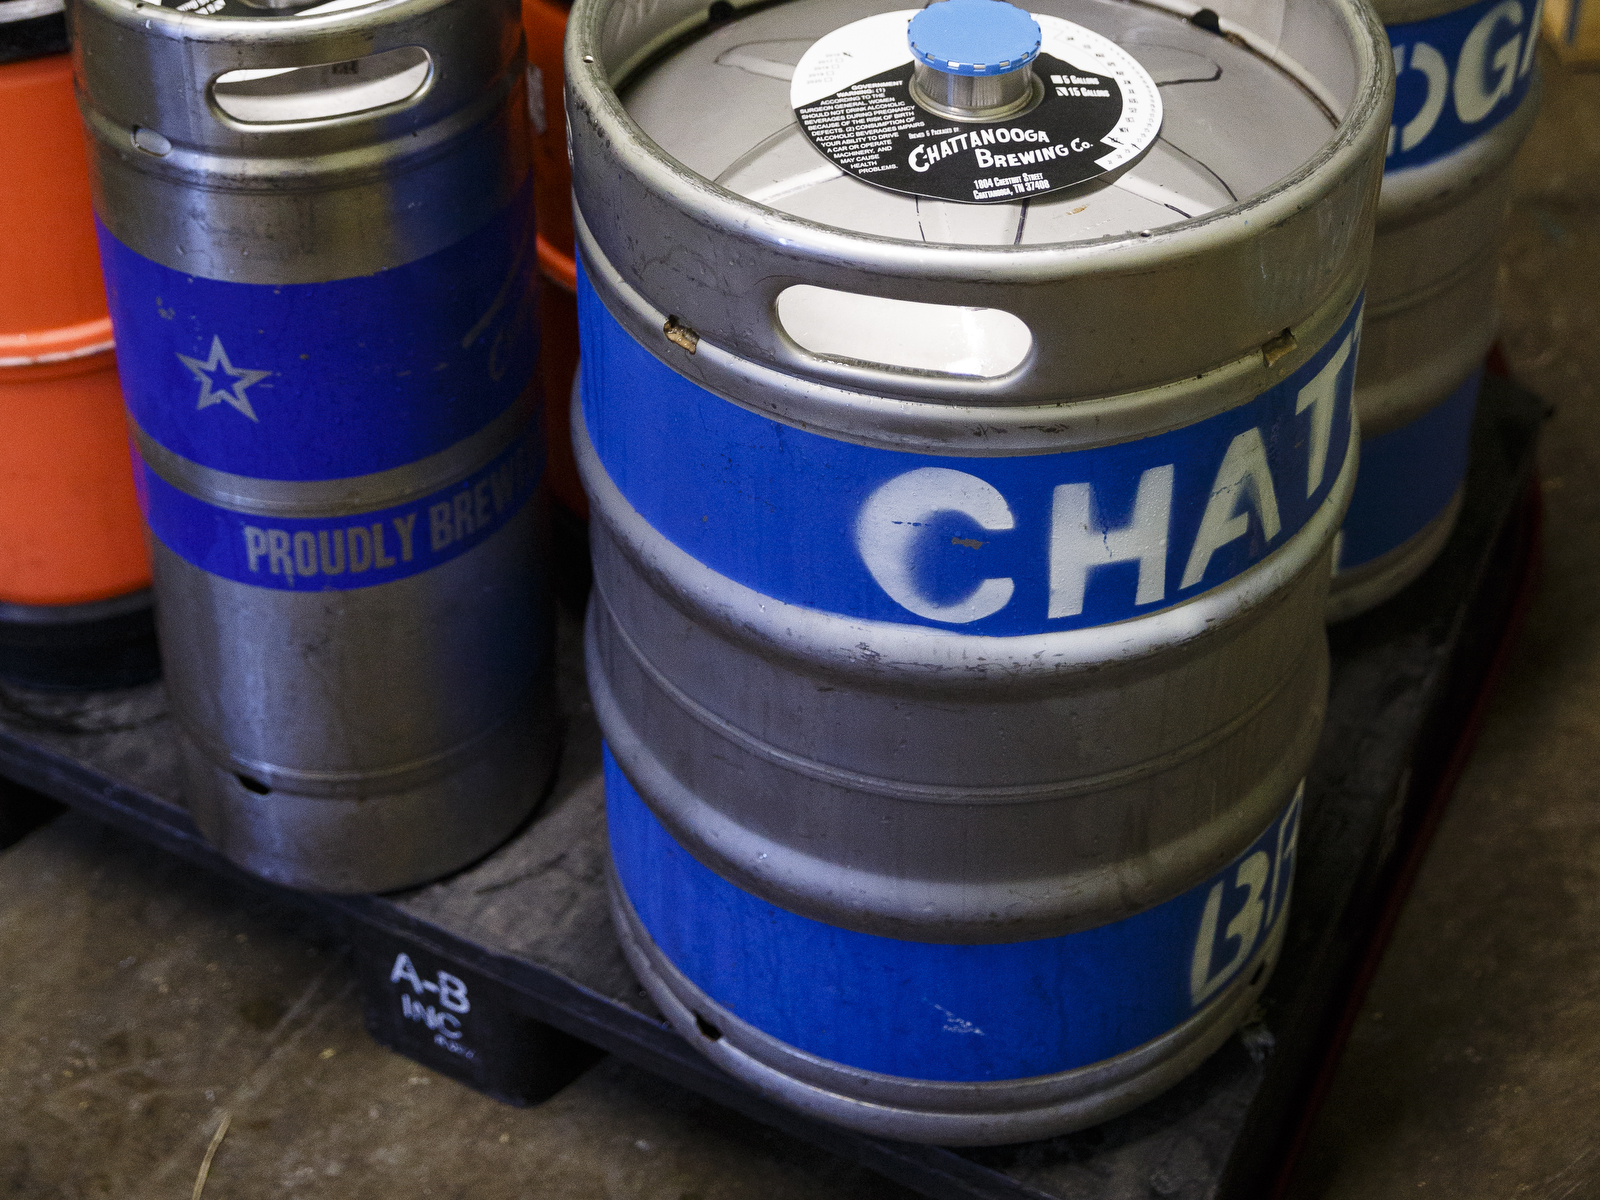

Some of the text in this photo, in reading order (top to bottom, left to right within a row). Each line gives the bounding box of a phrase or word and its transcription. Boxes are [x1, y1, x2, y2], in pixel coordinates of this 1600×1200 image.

[1068, 87, 1080, 96] 15
[908, 128, 1050, 172] CHATTANOOGA
[975, 148, 1070, 168] BREWING
[973, 178, 994, 189] 1804
[1022, 172, 1044, 182] STREET
[1013, 183, 1025, 193] TN
[1025, 180, 1050, 192] 37408
[857, 297, 1362, 625] CHAT
[242, 457, 537, 588] PROUDLY BREW
[390, 952, 471, 1014] A-B
[401, 993, 463, 1040] INC
